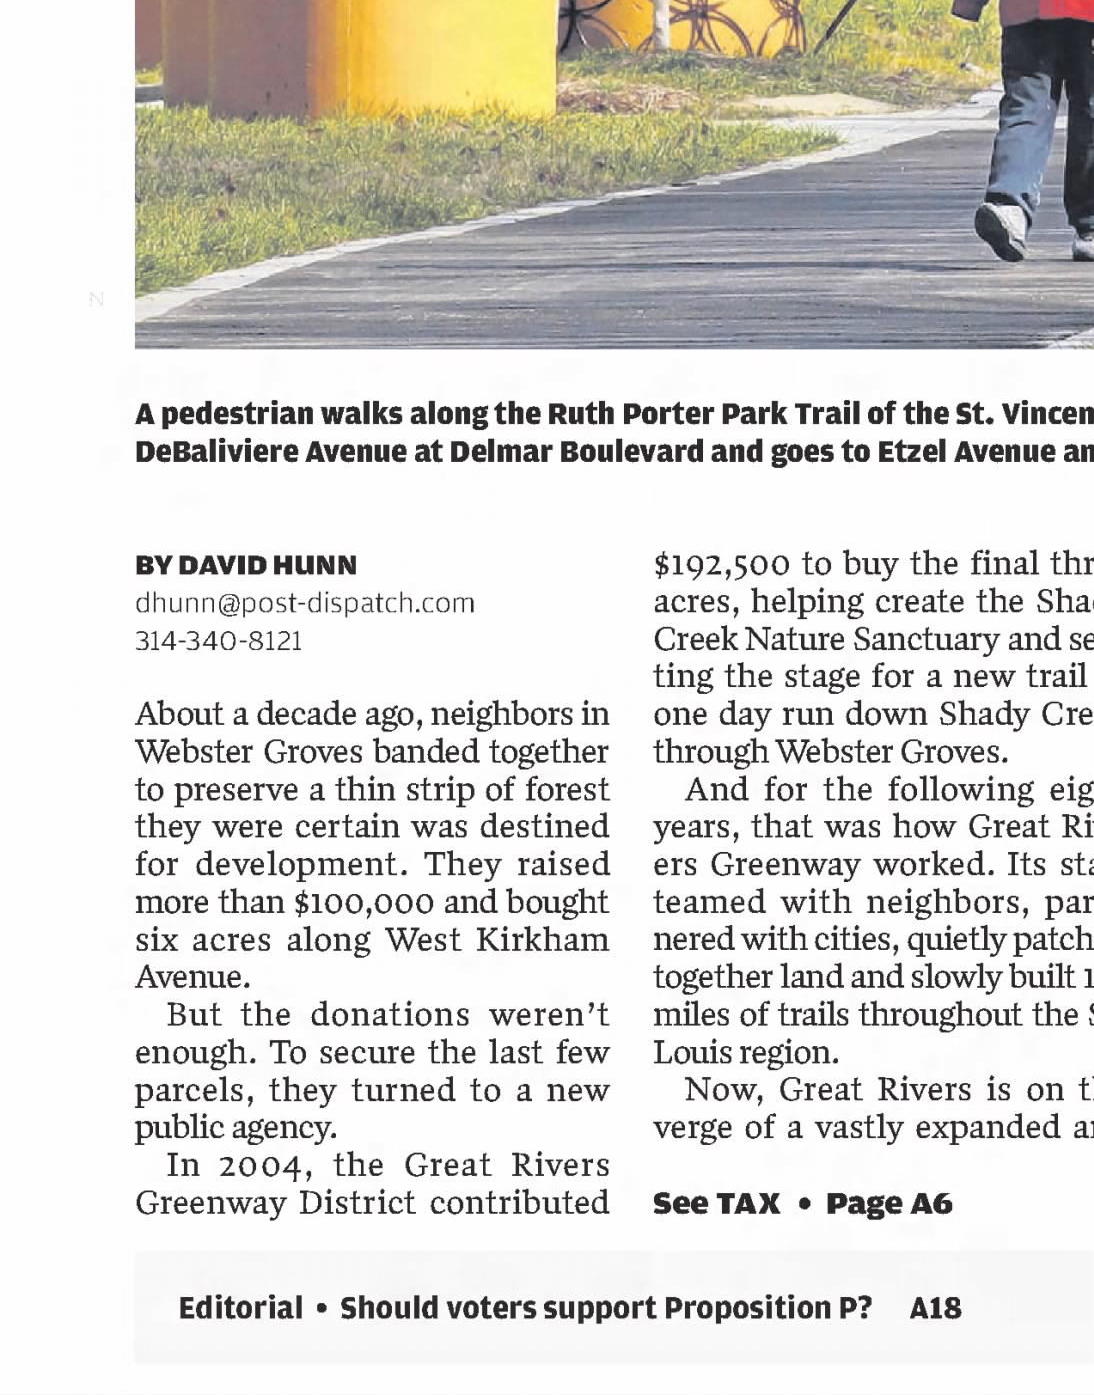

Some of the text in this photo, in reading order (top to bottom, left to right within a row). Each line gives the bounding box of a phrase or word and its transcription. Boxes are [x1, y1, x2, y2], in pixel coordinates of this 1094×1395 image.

[134, 402, 156, 425] A
[161, 399, 314, 430] pedestrian
[320, 400, 403, 425] walks
[410, 400, 489, 431] along
[493, 400, 542, 426] the
[548, 400, 615, 426] Ruth
[623, 401, 715, 426] Porter
[722, 400, 788, 425] Park
[794, 399, 861, 425] Trail
[867, 399, 897, 425] of
[902, 400, 950, 426] the
[955, 401, 995, 426] St.
[135, 437, 299, 463] DeBaliviere
[304, 440, 408, 463] Avenue
[414, 438, 444, 463] at
[450, 437, 554, 463] Delmar
[560, 437, 704, 463] Boulevard
[711, 437, 763, 463] and
[771, 442, 835, 469] goes
[840, 438, 871, 463] to
[878, 437, 947, 463] Etzel
[953, 440, 1057, 464] Avenue
[135, 554, 357, 576] BY DAVID HUNN
[655, 550, 790, 582] $192,500
[801, 550, 832, 576] to
[842, 549, 900, 582] buy
[909, 549, 959, 576] the
[970, 549, 1040, 576] final
[135, 590, 475, 619] dhunn@post-dispatch.com
[135, 630, 302, 651] 314-340-8121
[134, 699, 610, 733] About a decade ago, neighbors in
[652, 887, 767, 914] teamed
[779, 887, 853, 914] with
[866, 887, 1029, 921] neighbors,
[136, 1188, 611, 1222] Greenway District contributed
[653, 1191, 953, 1221] See TAX Page A6
[179, 1293, 963, 1325] Editorial Should voters support Proposition P? A18
